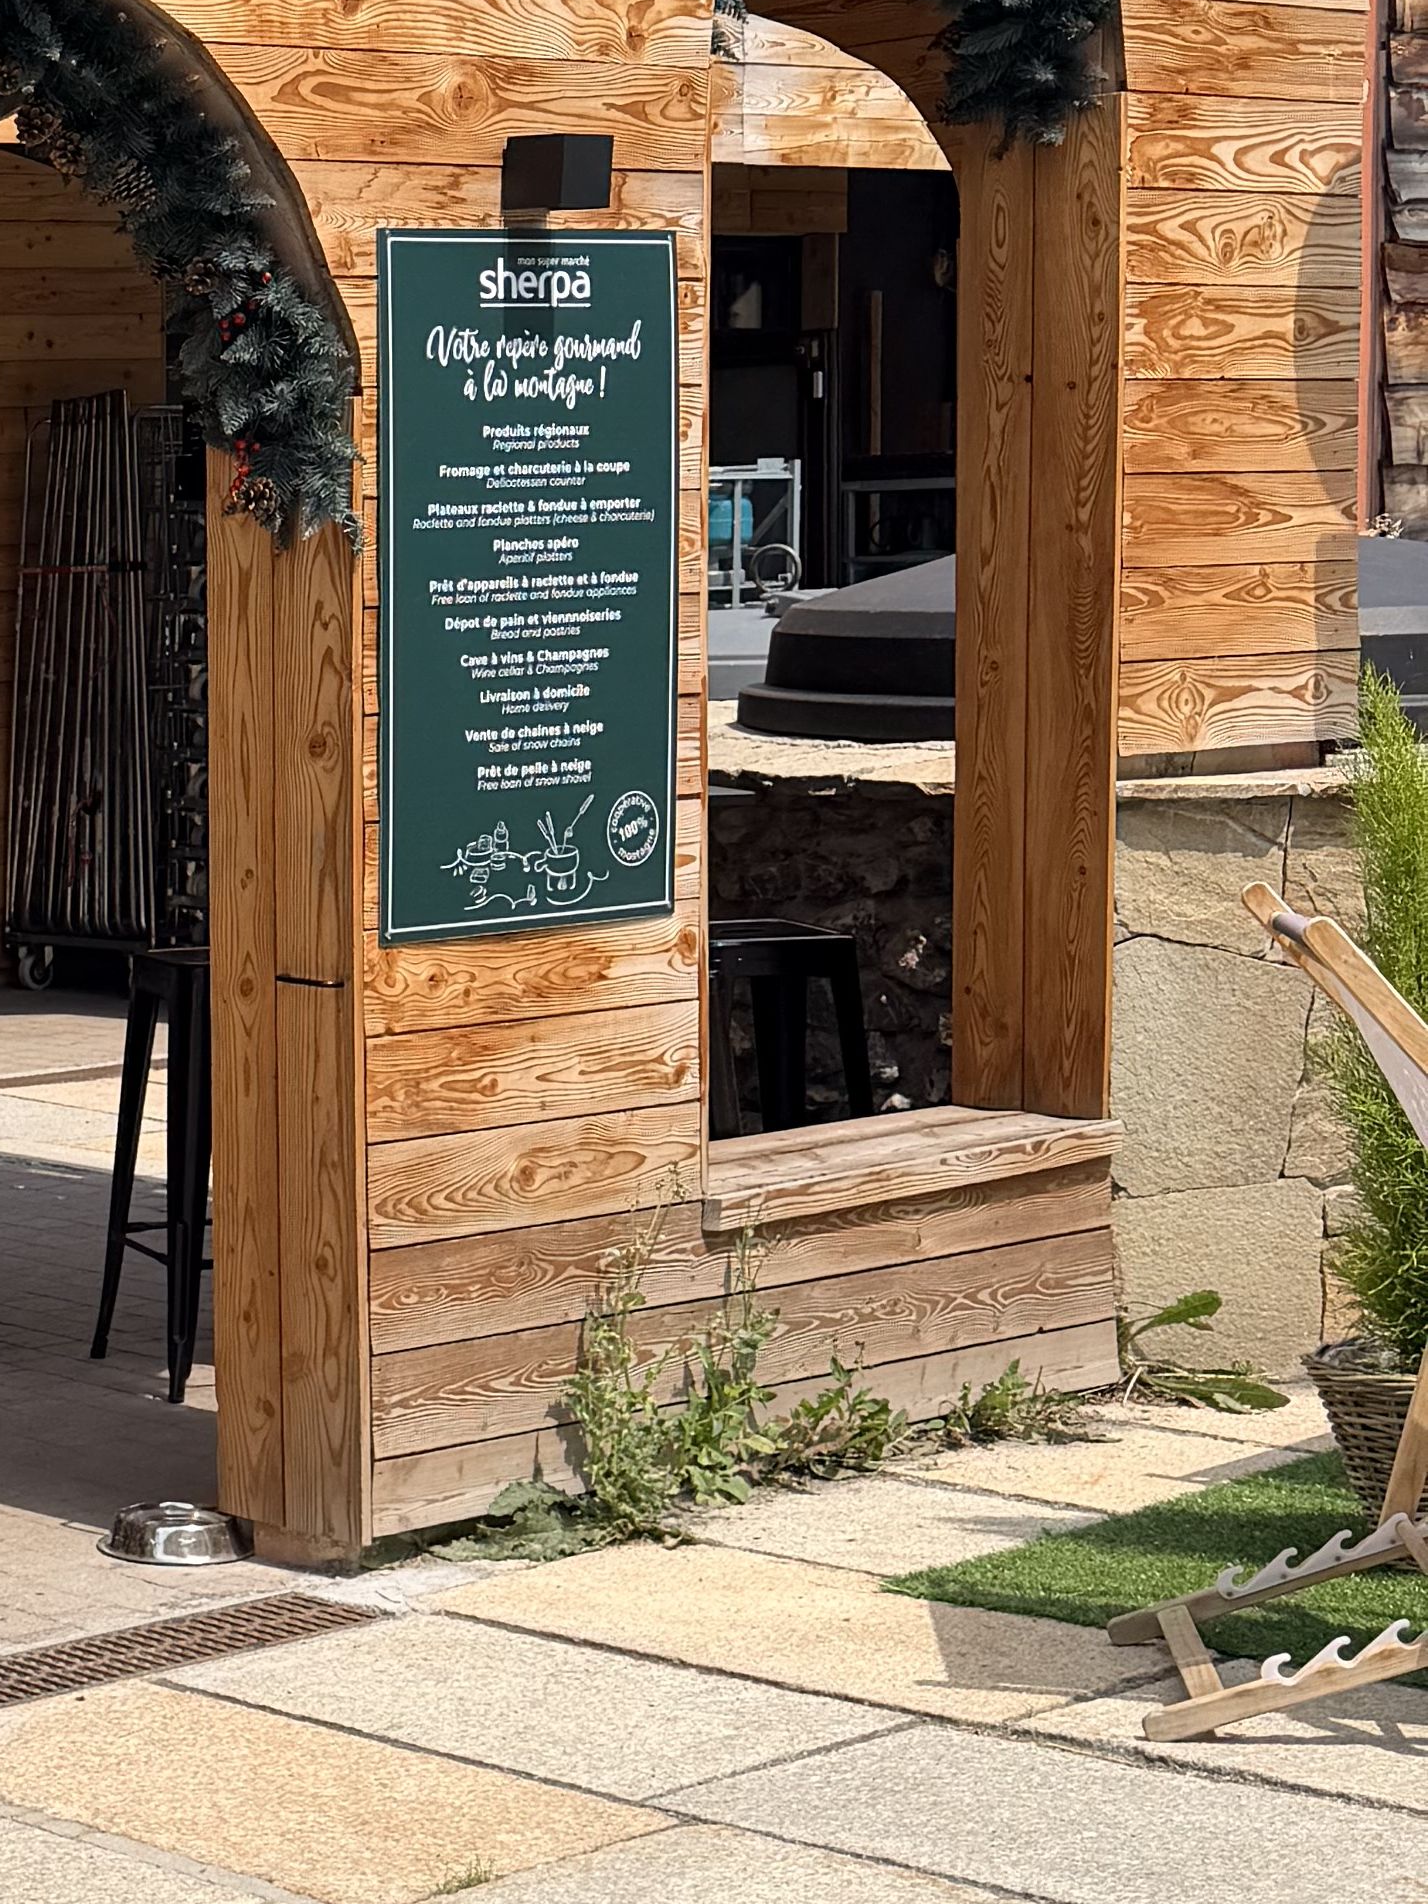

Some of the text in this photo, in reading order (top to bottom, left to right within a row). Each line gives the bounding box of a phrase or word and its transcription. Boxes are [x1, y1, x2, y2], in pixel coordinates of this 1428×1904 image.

[518, 255, 589, 267] mon super marché
[479, 257, 591, 307] sherpa
[426, 319, 642, 370] Votre repère gourmand
[464, 369, 478, 401] à
[483, 360, 508, 401] la
[515, 367, 594, 409] montagne
[483, 423, 590, 439] Produits régionaux
[493, 439, 580, 453] Regional products
[439, 460, 631, 479] Fromage et charcuterie à la coupe
[486, 476, 586, 489] Delicatessen counter
[428, 497, 641, 517] Plateaux raclette & fondue à emporter
[412, 508, 655, 530] Raclette and fondue platters (cheese & charcuterie)
[493, 535, 580, 552] Planches apéro
[535, 551, 573, 565] platters
[429, 570, 639, 593] Prêt d'appareils à raclette et à fondue
[431, 585, 637, 606] Free loan of raclette and fondue appliances
[483, 615, 497, 627] de
[500, 613, 524, 629] pain
[527, 612, 539, 625] et
[490, 625, 581, 640] Bread and pastries
[460, 648, 610, 667] Cave à vins & Champagnes
[471, 662, 599, 680] Wine cellar & Champagnes
[479, 684, 591, 704] Livraison à domicile
[501, 700, 570, 715] Home delivery
[465, 729, 498, 742] Vente
[500, 727, 516, 739] de
[563, 721, 571, 735] à
[572, 719, 604, 736] neige
[488, 736, 581, 753] Sale of snow chains
[477, 758, 592, 778] Prêt de pelle à neige
[477, 771, 592, 791] Free loan of snow shovel
[619, 816, 648, 842] 100%
[617, 828, 655, 861] montagne
